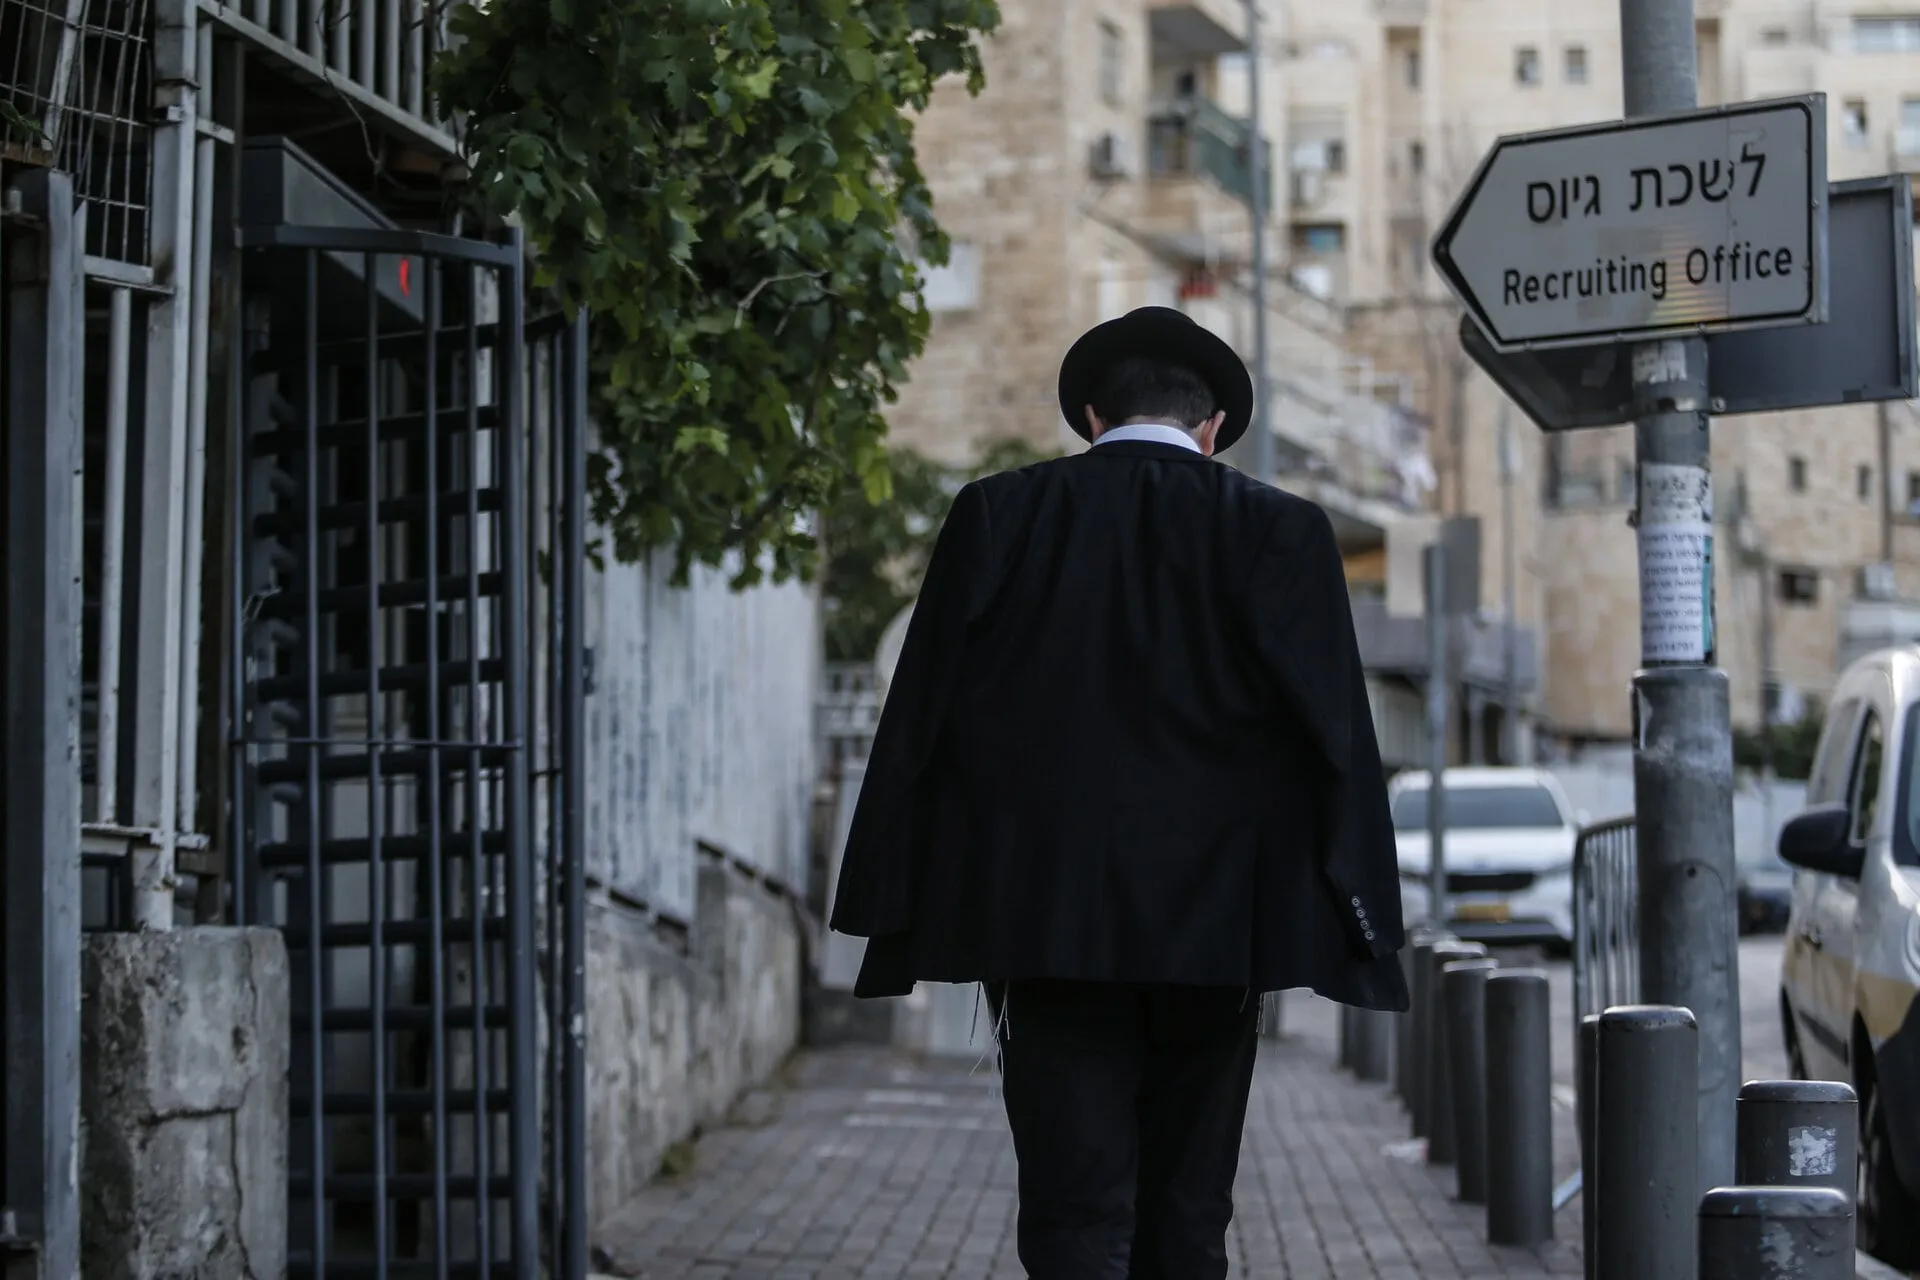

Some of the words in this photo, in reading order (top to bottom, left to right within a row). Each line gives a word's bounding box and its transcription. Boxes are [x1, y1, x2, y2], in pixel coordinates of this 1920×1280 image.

[1527, 174, 1601, 224] גיוס
[1629, 142, 1766, 212] לשכת
[1503, 255, 1667, 305] Recruiting
[1686, 242, 1793, 286] Office
